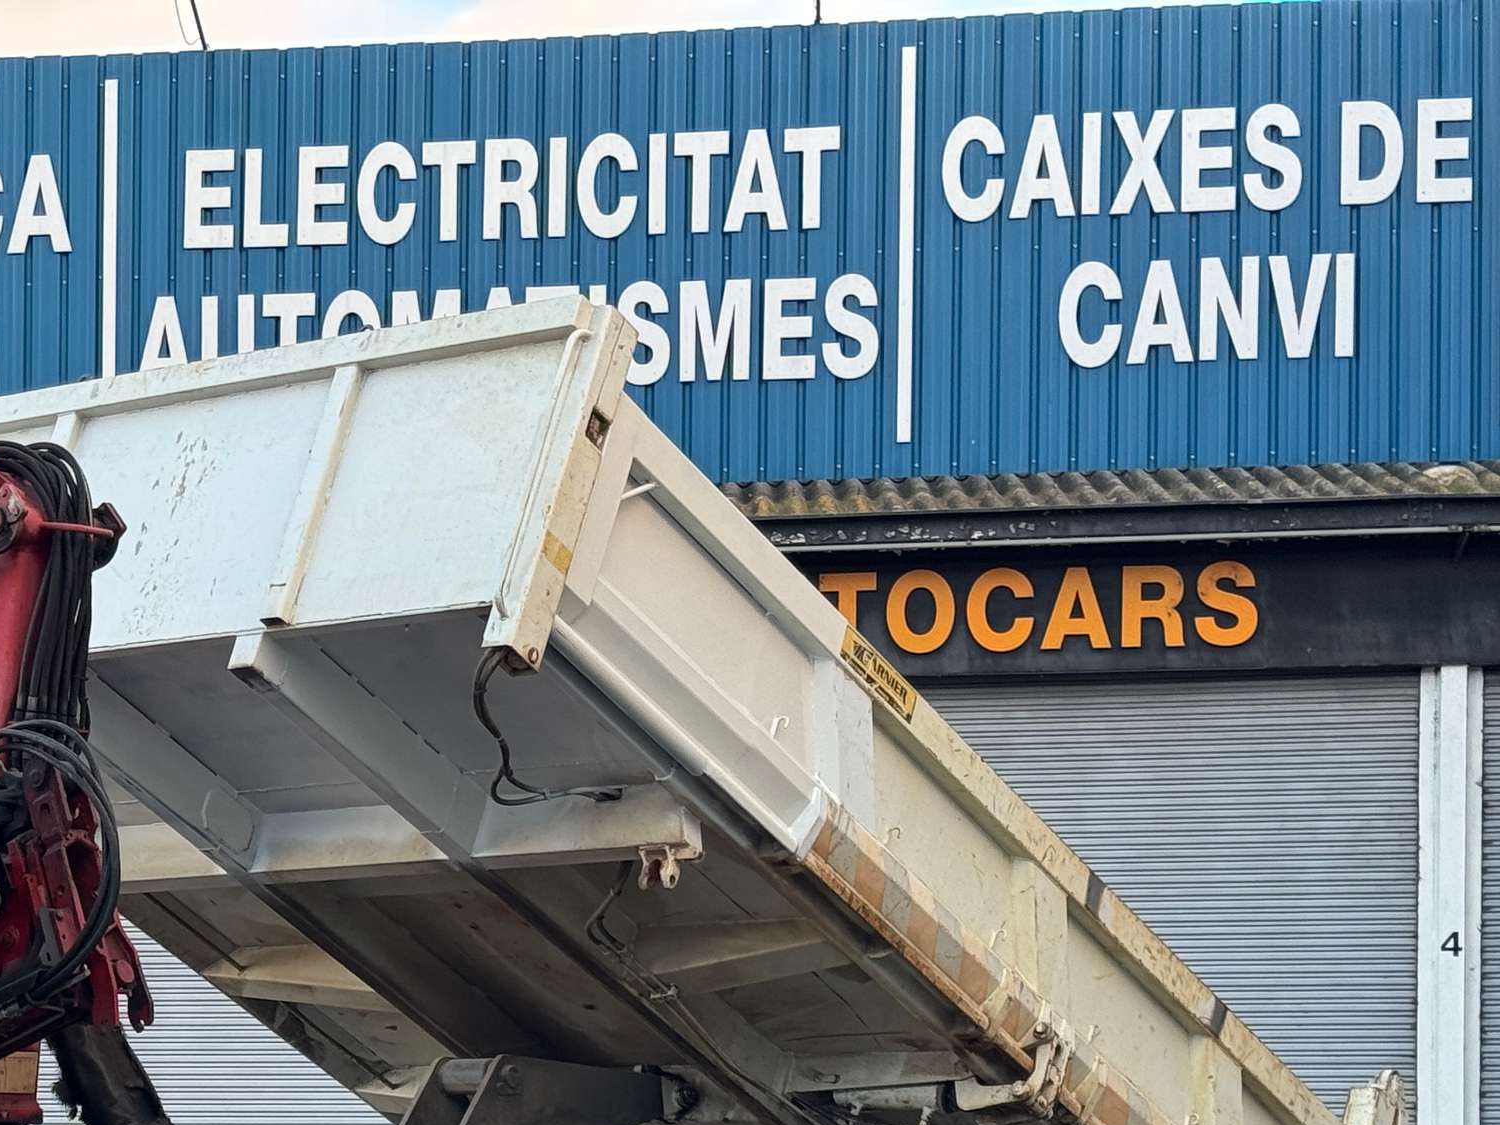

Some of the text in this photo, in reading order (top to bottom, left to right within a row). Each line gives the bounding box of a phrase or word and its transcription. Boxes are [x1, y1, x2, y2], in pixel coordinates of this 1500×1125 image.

[183, 125, 842, 250] ELECTRICITAT
[941, 97, 1473, 223] CAIXES DE
[140, 273, 881, 387] AUTSMES
[1058, 252, 1356, 369] CANVI
[1441, 931, 1463, 957] 4
